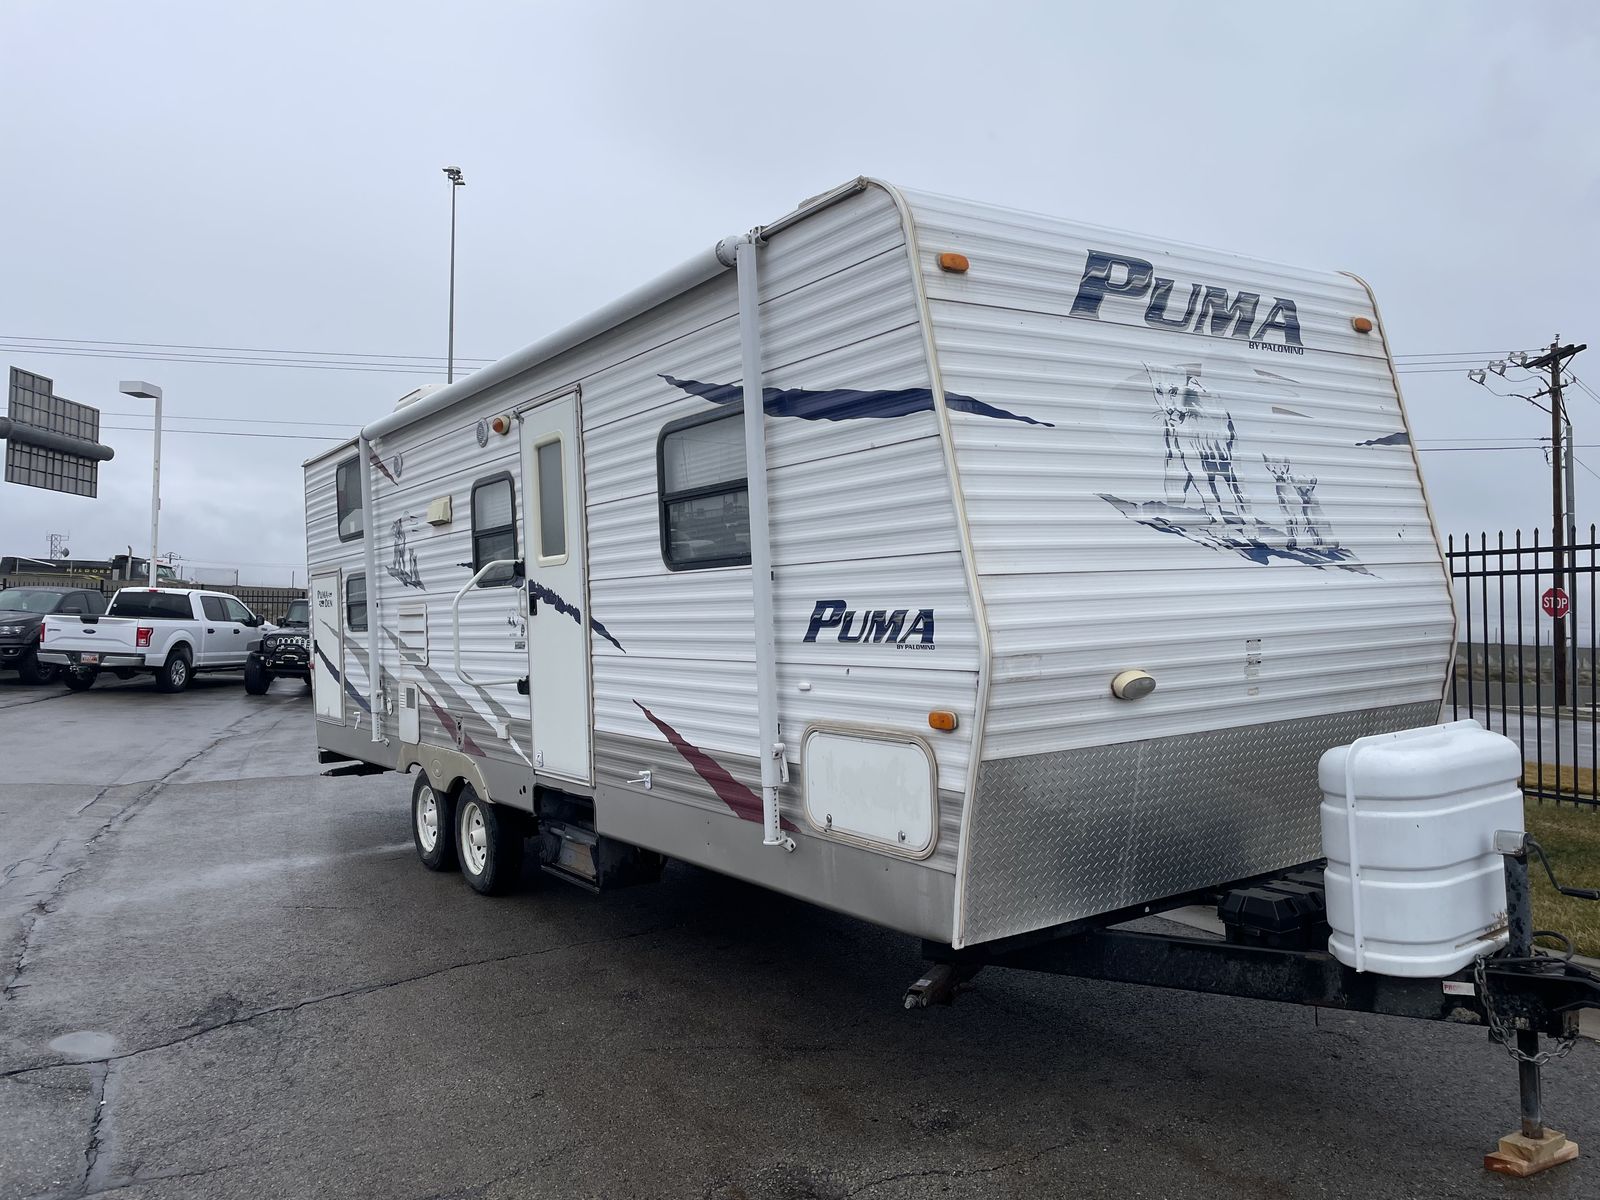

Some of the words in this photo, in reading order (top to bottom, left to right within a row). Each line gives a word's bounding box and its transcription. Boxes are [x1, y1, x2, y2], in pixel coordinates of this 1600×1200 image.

[1069, 249, 1303, 346] PUMA
[1249, 341, 1260, 349] BY
[1261, 342, 1304, 355] PALOMINO
[803, 599, 935, 644] PUMA
